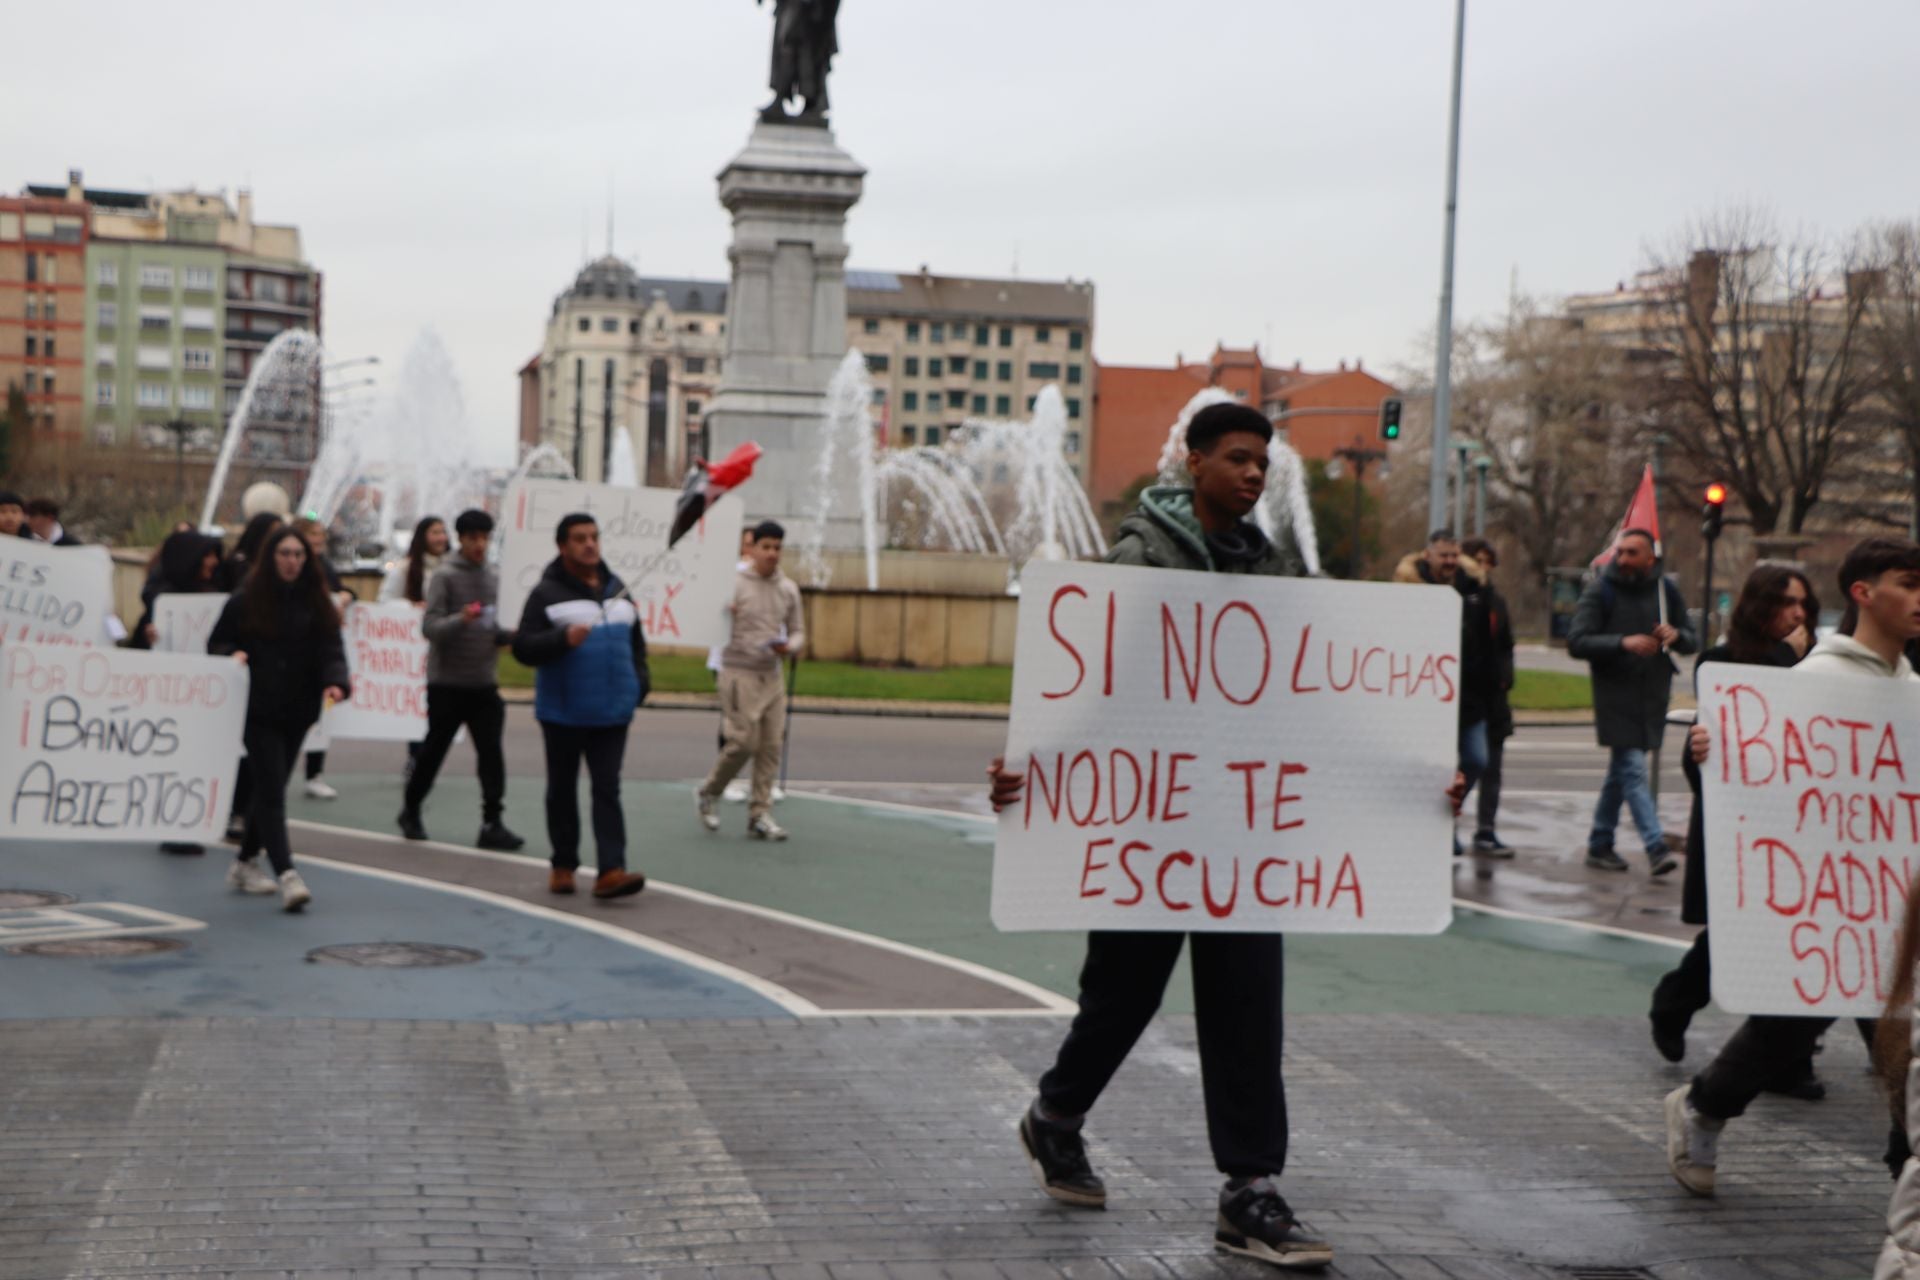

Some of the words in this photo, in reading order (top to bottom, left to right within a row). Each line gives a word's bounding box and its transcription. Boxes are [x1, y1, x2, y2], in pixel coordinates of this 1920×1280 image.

[352, 605, 418, 644] FINANC
[1042, 584, 1115, 699] SI
[1161, 601, 1271, 705] NO
[1291, 624, 1458, 702] LUCHAS
[7, 647, 67, 693] POR
[351, 673, 429, 718] EDUCAC
[1715, 683, 1906, 787] ¡BASTA
[1225, 762, 1309, 831] TE
[1795, 787, 1920, 843] MENT
[1080, 838, 1363, 918] ESCUCHA
[1735, 815, 1914, 923] ¡DADN
[1791, 921, 1900, 1005] SOL
